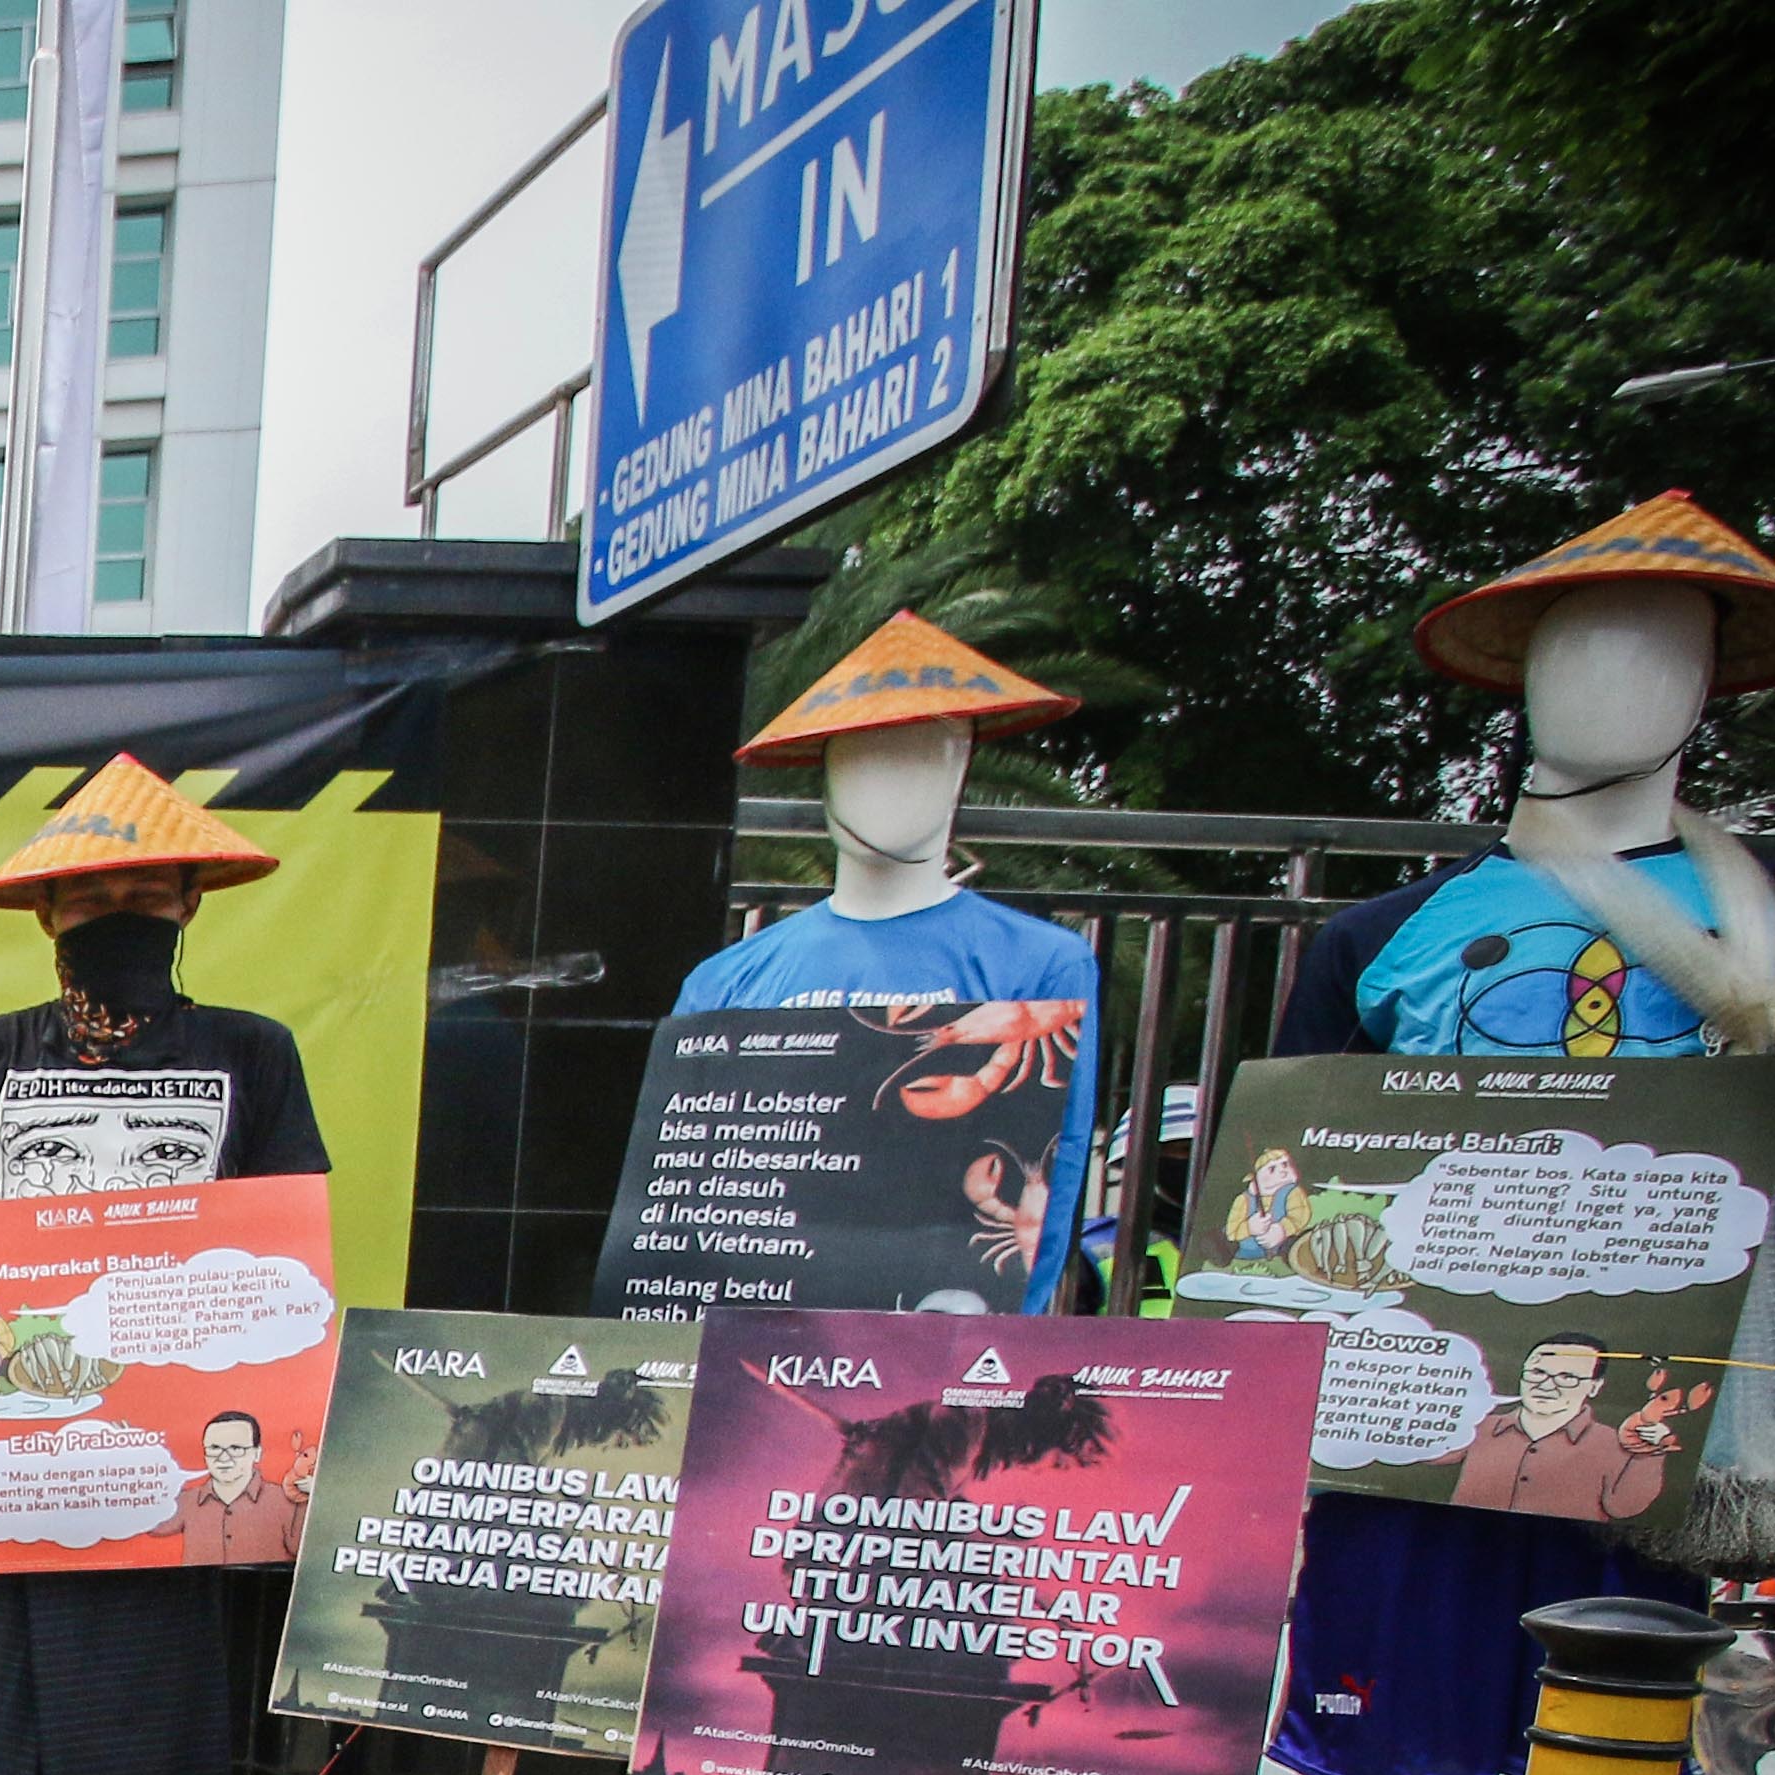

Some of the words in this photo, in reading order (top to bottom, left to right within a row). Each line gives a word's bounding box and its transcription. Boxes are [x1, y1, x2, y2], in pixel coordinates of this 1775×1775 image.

[797, 111, 885, 287] IN
[612, 405, 713, 517] GEDUNG
[721, 356, 791, 452] MINA
[804, 272, 923, 401] BAHARI
[941, 248, 958, 320] 1
[606, 486, 707, 586] GEDUNG
[715, 438, 785, 529] MINA
[797, 356, 916, 483] BAHARI
[928, 336, 950, 409] 2
[676, 1036, 729, 1055] KIARA
[8, 1080, 61, 1098] PEDIH
[65, 1081, 89, 1095] itu
[92, 1083, 147, 1096] adalah
[151, 1080, 221, 1098] KETIKA
[1383, 1071, 1461, 1093] KIARA
[1477, 1072, 1534, 1090] AMUK
[1538, 1073, 1615, 1091] BAHARI
[664, 1092, 735, 1114] Andai
[743, 1092, 845, 1115] Lobster
[659, 1120, 707, 1142] bisa
[713, 1121, 821, 1143] memilih
[1301, 1128, 1455, 1152] Masyarakat
[1461, 1132, 1563, 1155] Bahari:
[1536, 1167, 1571, 1180] bos.
[1582, 1169, 1625, 1182] Kata
[1633, 1170, 1685, 1187] siapa
[1691, 1172, 1728, 1185] kita
[36, 1209, 93, 1228] KIARA
[633, 1231, 687, 1253] atau
[697, 1231, 814, 1259] Vietnam,
[106, 1252, 176, 1273] Bahari:
[394, 1348, 485, 1379] KIARA
[768, 1355, 881, 1389] KIARA
[1074, 1366, 1135, 1387] AMUK
[1140, 1367, 1231, 1390] BAHARI
[9, 1435, 63, 1456] Edhy
[66, 1430, 166, 1451] Prabowo:
[44, 1467, 95, 1484] dengan
[99, 1466, 135, 1481] siapa
[140, 1464, 168, 1478] saja
[413, 1457, 588, 1497] OMNIBUS
[593, 1473, 680, 1503] LAW
[768, 1490, 815, 1521] DI
[823, 1496, 1045, 1538] OMNIBUS
[1056, 1486, 1191, 1547] LAW
[357, 1516, 615, 1567] PERAMPASAN
[333, 1547, 497, 1593] PEKERJA
[751, 1527, 1181, 1590] DPR/PEMERINTAH
[791, 1568, 872, 1602] ITU
[876, 1574, 1119, 1625] MAKELAR
[743, 1601, 904, 1675] UNTUK
[910, 1615, 1178, 1707] INVESTOR
